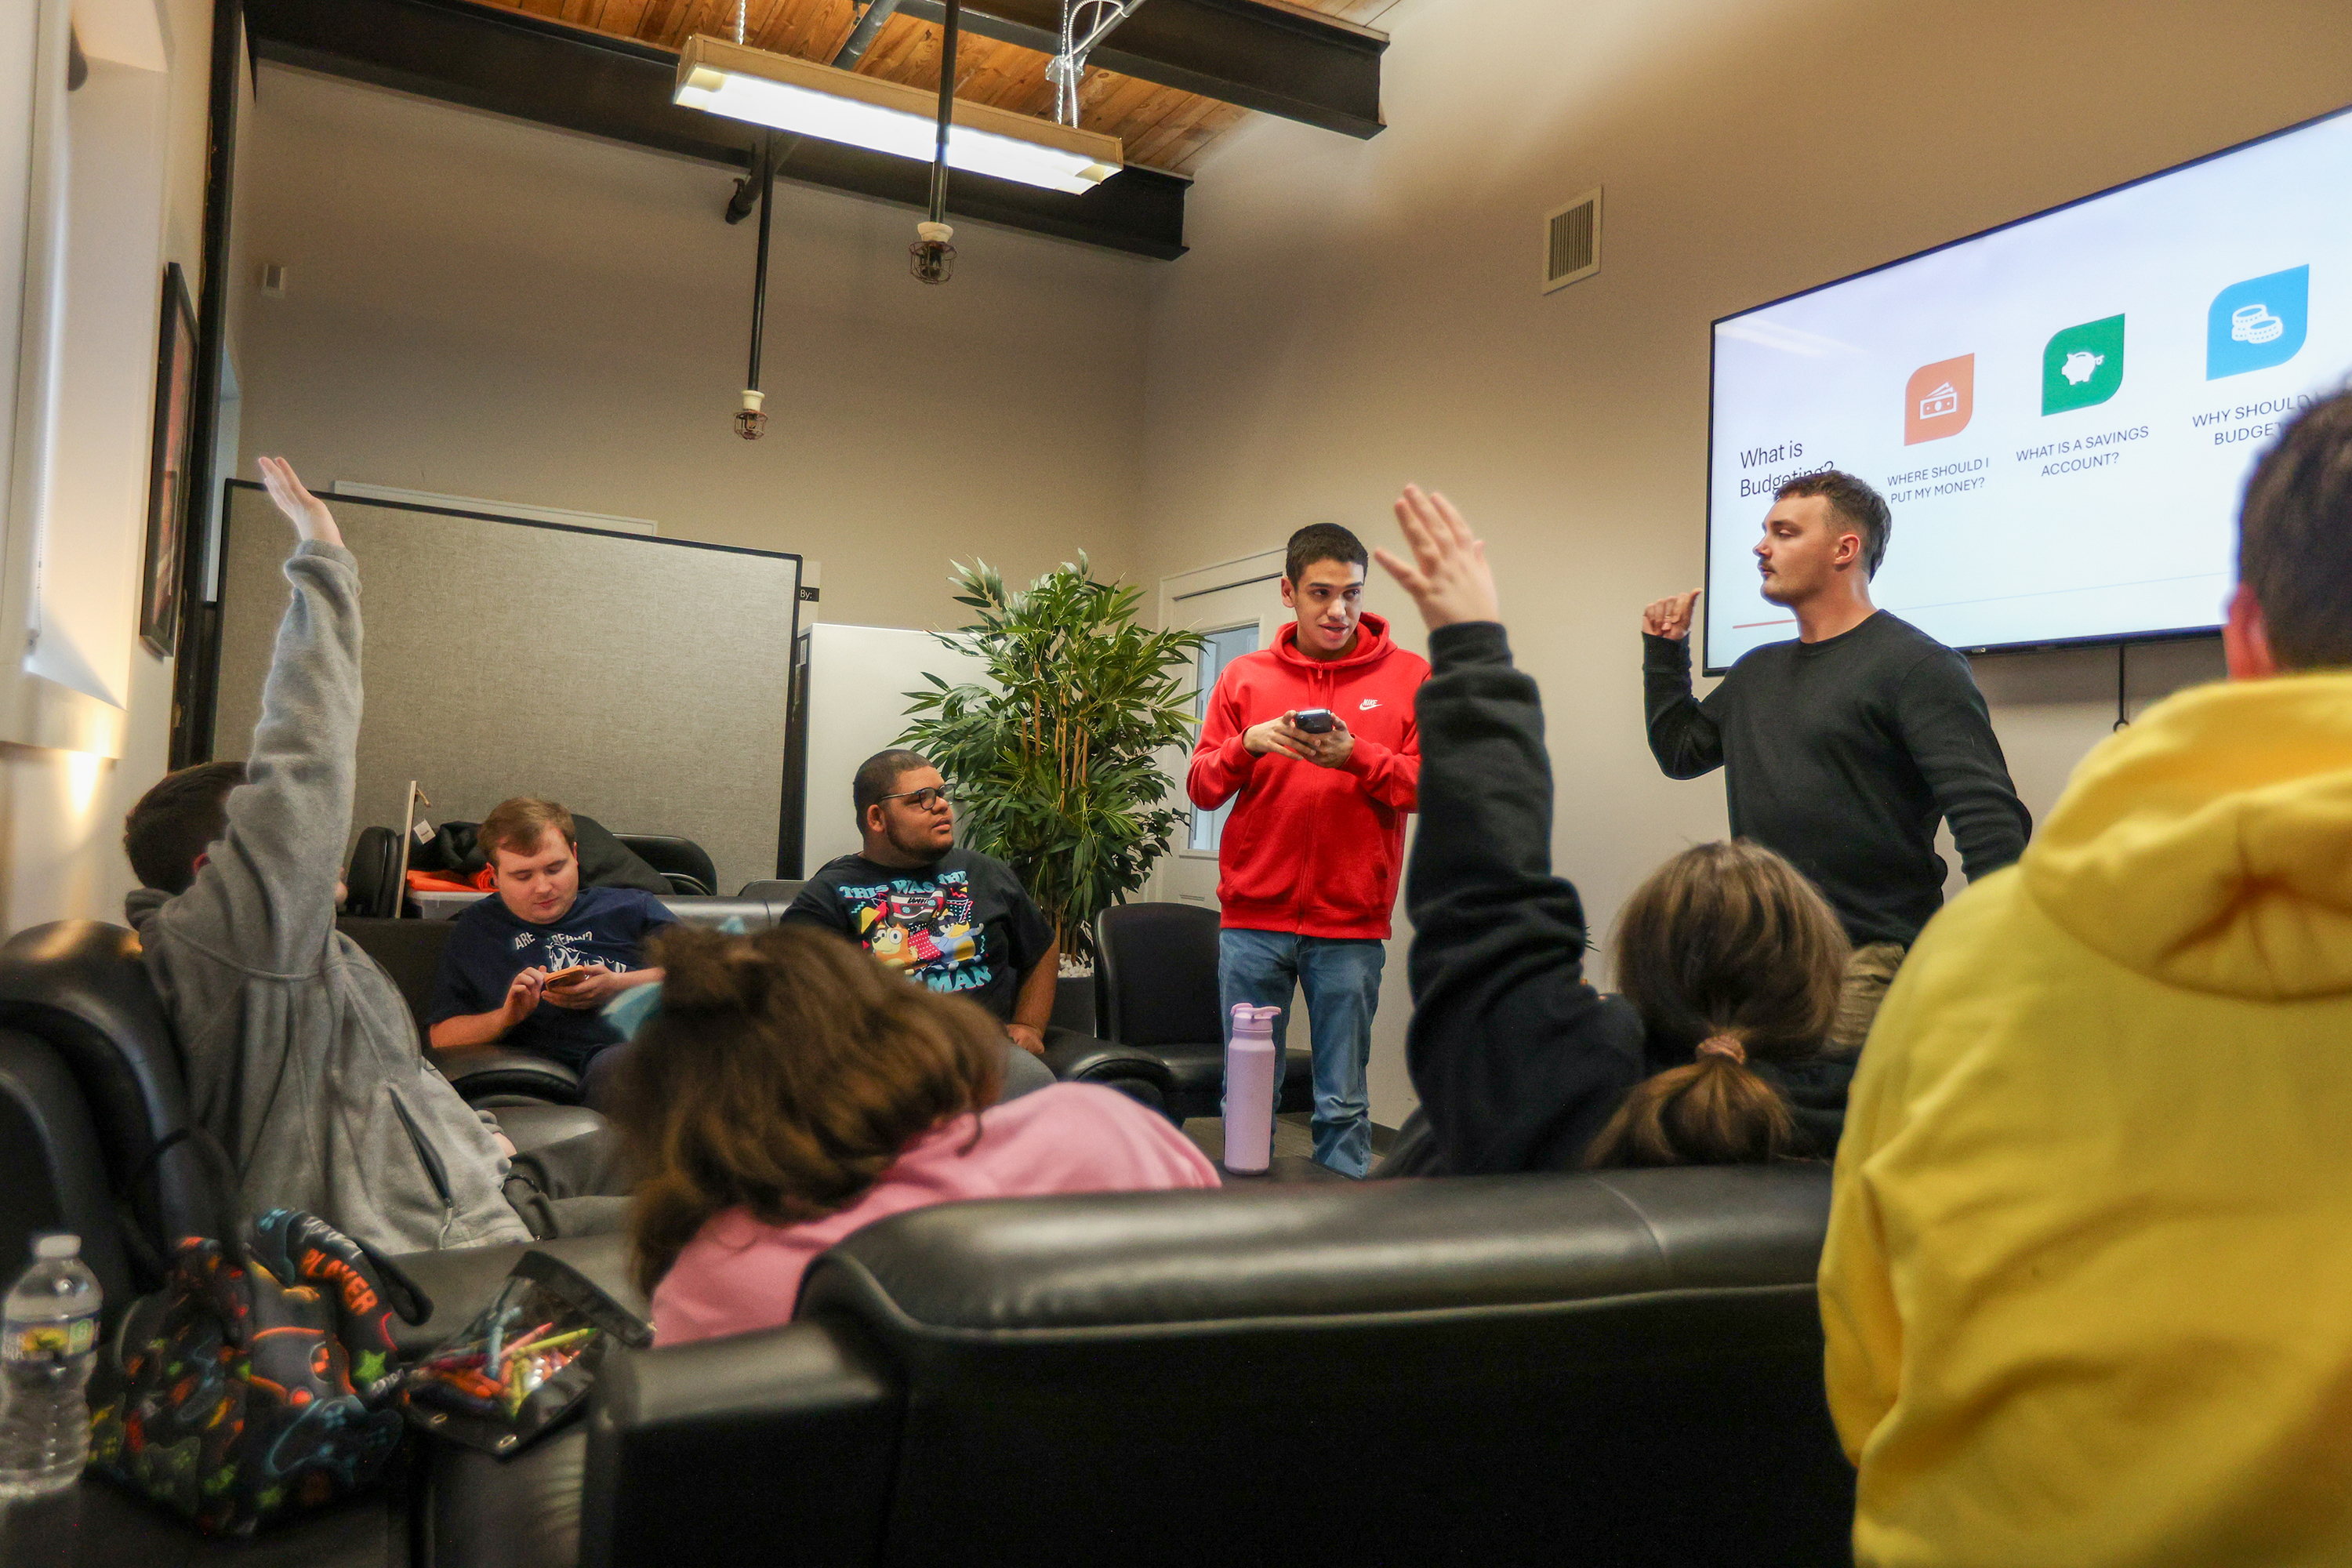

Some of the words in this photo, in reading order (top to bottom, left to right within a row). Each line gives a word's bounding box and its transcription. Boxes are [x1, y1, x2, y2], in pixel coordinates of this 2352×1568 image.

[2192, 408, 2231, 428] WHY
[2234, 394, 2310, 420] SHOULD
[1740, 445, 1784, 469] What
[1790, 441, 1802, 459] is
[2016, 444, 2054, 462] WHAT
[2058, 441, 2070, 454] IS
[2073, 439, 2082, 452] A
[2085, 426, 2149, 448] SAVINGS
[1887, 469, 1929, 486] WHERE
[1931, 459, 1983, 478] SHOULD
[1986, 457, 1989, 468] I
[2041, 452, 2119, 477] ACCOUNT?
[1890, 490, 1912, 504] PUT
[1915, 487, 1932, 499] MY
[1934, 477, 1985, 496] MONEY?
[839, 884, 890, 899] THIS
[891, 880, 936, 895] WAS
[514, 931, 536, 950] ARE
[927, 965, 992, 993] MAN
